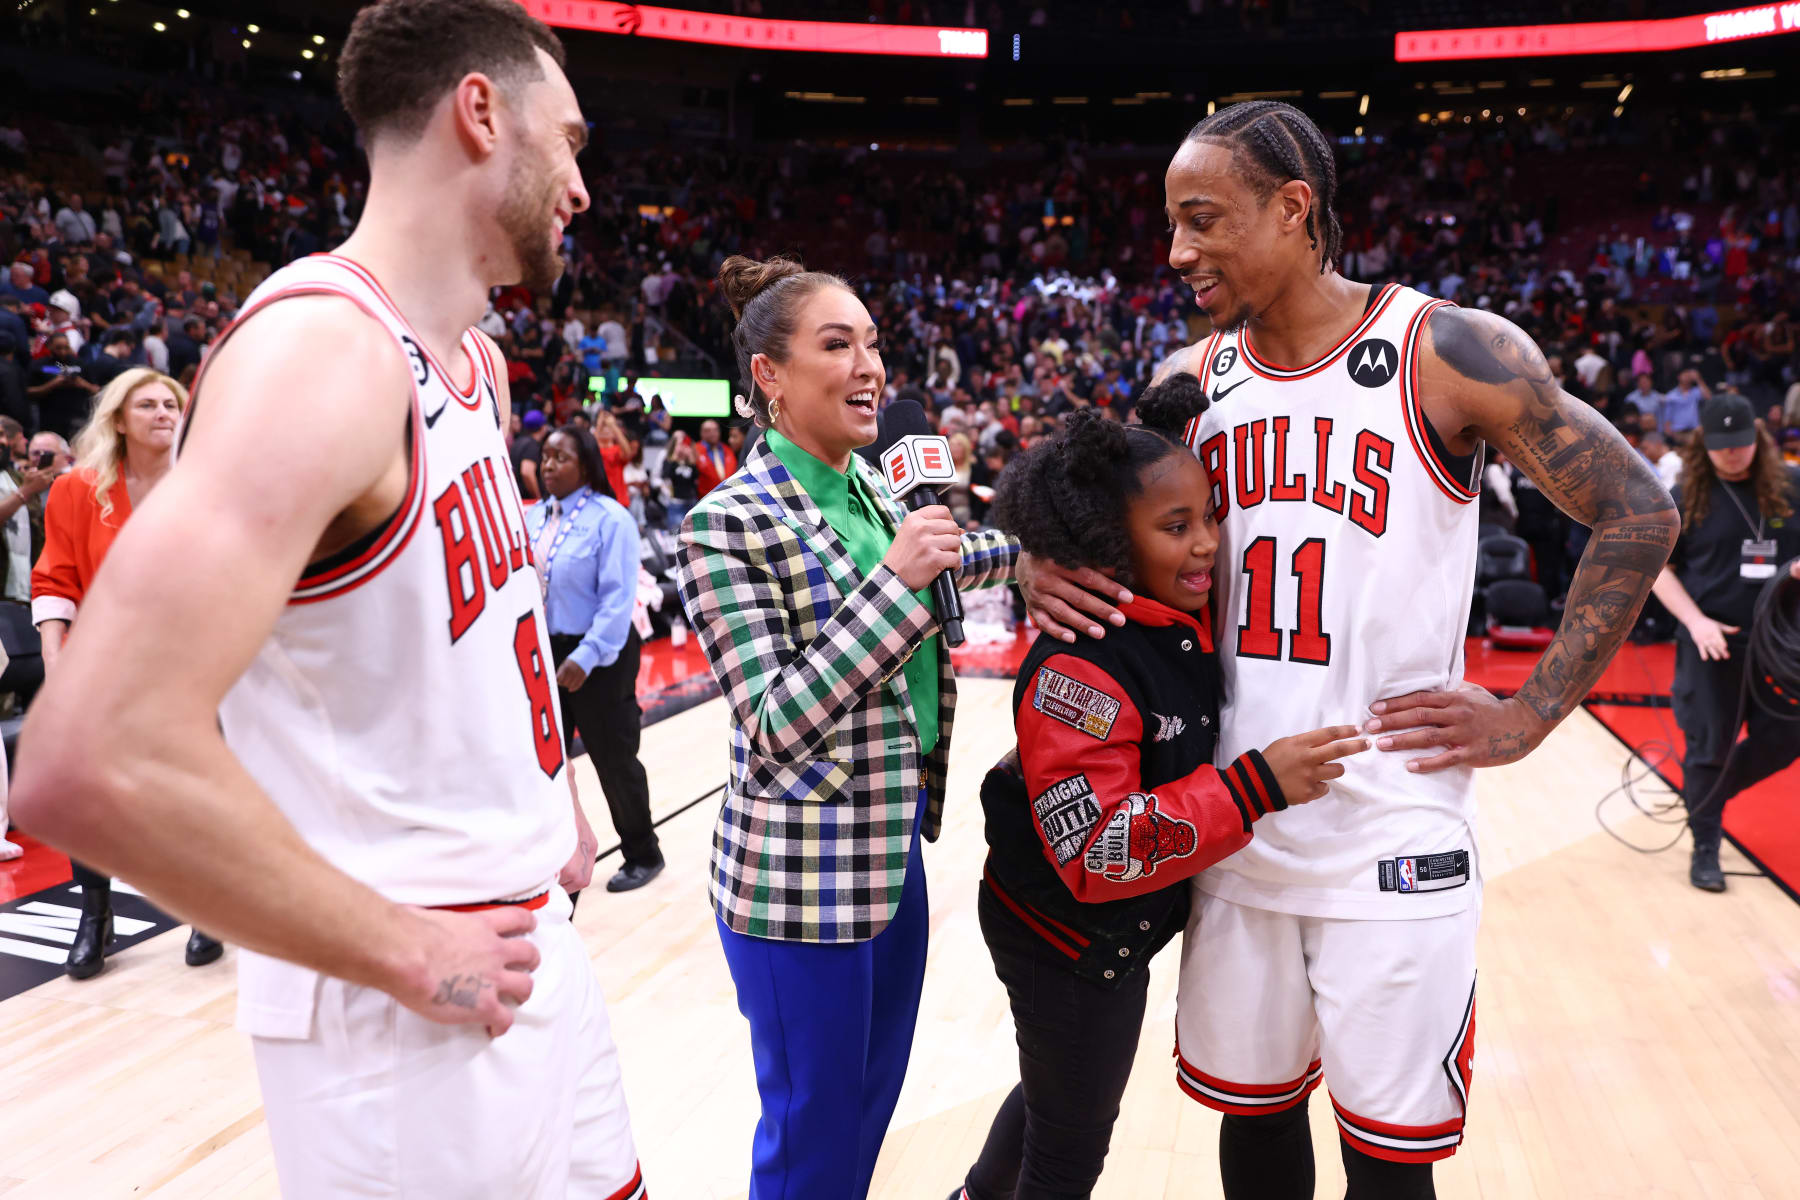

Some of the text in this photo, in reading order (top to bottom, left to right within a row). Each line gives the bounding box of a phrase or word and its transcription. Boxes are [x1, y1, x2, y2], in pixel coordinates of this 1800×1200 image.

[1201, 415, 1394, 538] BULLS
[1236, 536, 1331, 666] 11
[513, 608, 564, 780] 8
[1063, 681, 1094, 709] STAR
[1090, 693, 1118, 721] 2022
[1033, 775, 1088, 818] STRAIGHT
[1042, 797, 1101, 841] OUTTA
[1107, 812, 1126, 861] BULLS
